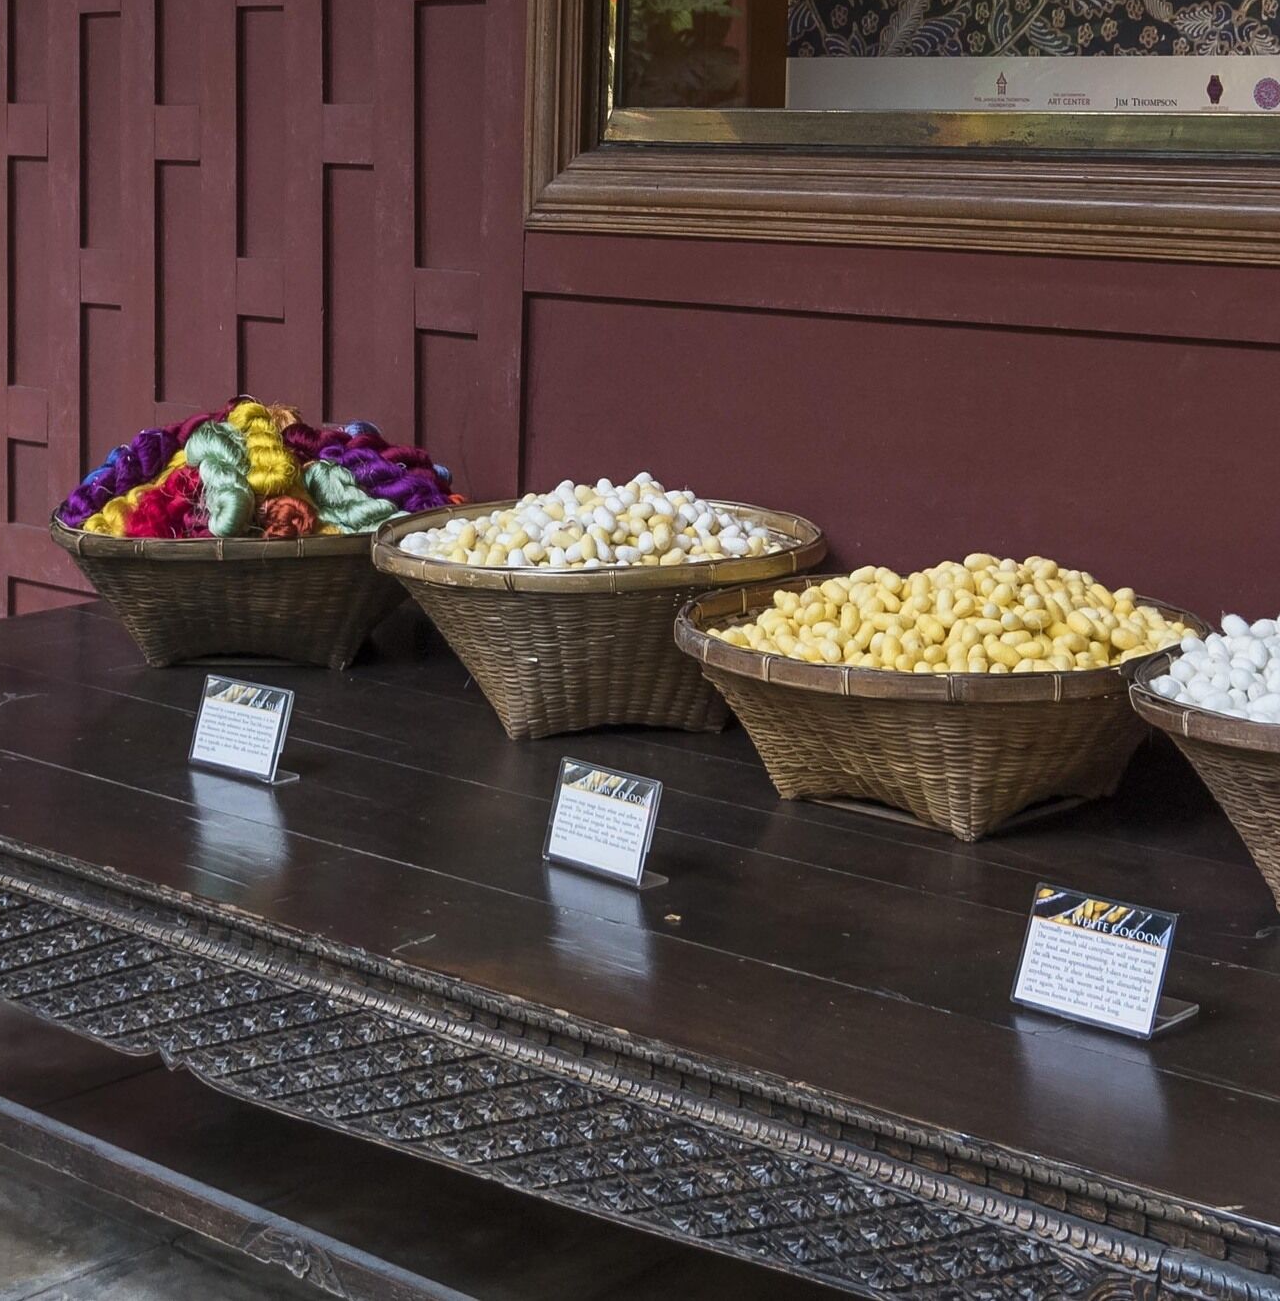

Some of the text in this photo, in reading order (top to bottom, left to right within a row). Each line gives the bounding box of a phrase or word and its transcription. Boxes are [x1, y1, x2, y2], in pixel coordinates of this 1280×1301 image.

[1048, 97, 1090, 106] ART CENTER
[1115, 97, 1178, 108] JIM THOMPSON
[1072, 913, 1161, 946] WHITE COCOON
